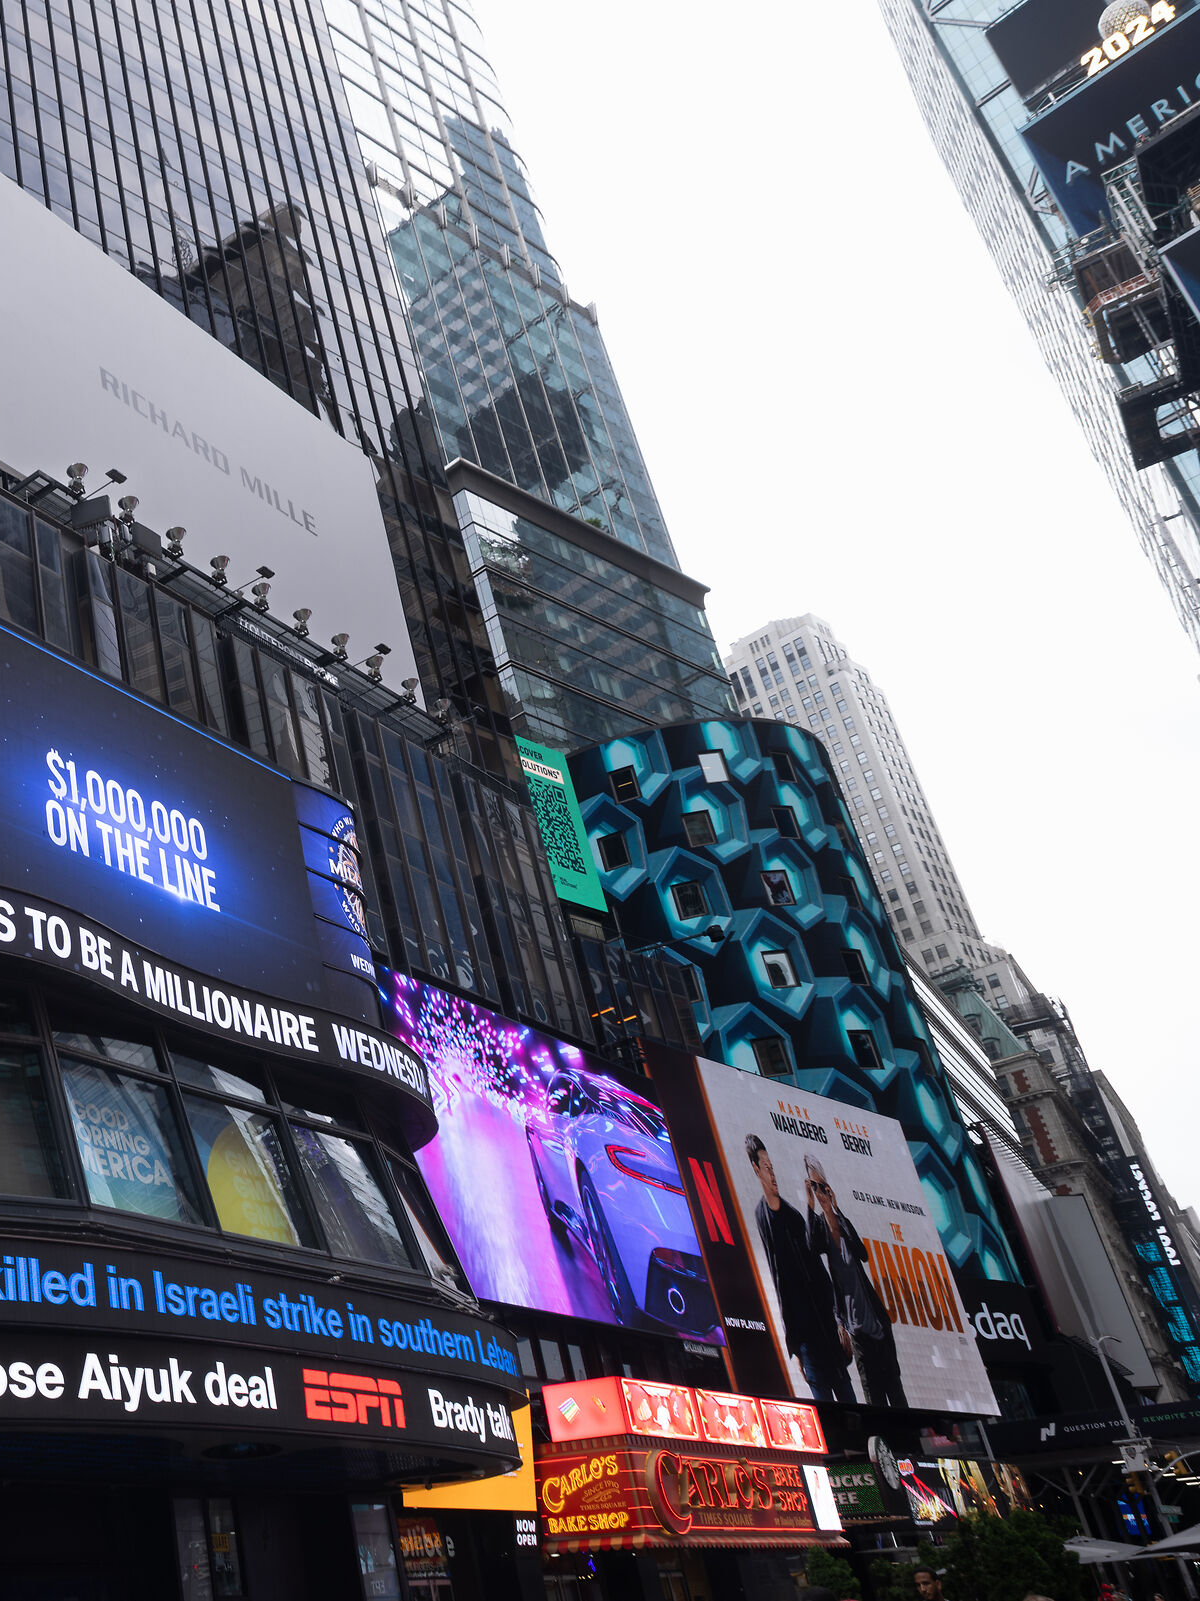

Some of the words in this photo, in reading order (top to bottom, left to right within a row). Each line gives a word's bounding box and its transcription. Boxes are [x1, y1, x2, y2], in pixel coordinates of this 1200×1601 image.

[1080, 0, 1177, 77] 2024
[99, 366, 231, 476] RICHARD
[240, 466, 319, 537] MILLE
[46, 748, 208, 861] $1,000,000
[45, 799, 90, 858] ON
[95, 819, 154, 885] THE
[159, 847, 221, 913] LINE
[24, 906, 72, 959] TO
[79, 926, 115, 980] BE
[120, 949, 140, 994] A
[142, 960, 320, 1053] MILLIONAIRE
[72, 1099, 129, 1131] GOOD
[777, 1099, 811, 1120] MARK
[834, 1116, 870, 1138] HALLE
[770, 1111, 828, 1144] WAHLBERG
[840, 1132, 874, 1157] BERRY
[852, 1190, 866, 1202] OLD
[865, 1193, 887, 1207] FLAME.
[886, 1199, 901, 1210] NEW
[889, 1222, 904, 1242] THE
[862, 1237, 964, 1333] UNION
[106, 1264, 145, 1312] in
[152, 1270, 258, 1327] Israeli
[263, 1291, 344, 1339] strike
[347, 1302, 375, 1345] in
[377, 1315, 474, 1361] southern
[725, 1317, 741, 1328] NOW
[740, 1319, 766, 1332] PLAYING
[77, 1352, 197, 1413] Aiyuk
[204, 1361, 278, 1411] deal
[302, 1368, 406, 1429] ESPN
[427, 1388, 486, 1444] Brady
[486, 1402, 514, 1442] talk
[1063, 1421, 1106, 1432] QUESTION
[1109, 1417, 1136, 1429] TODY
[1143, 1412, 1187, 1423] REWRITE
[542, 1454, 619, 1513] CARLO'S
[584, 1481, 603, 1497] SINCE
[604, 1479, 620, 1489] 1910
[771, 1466, 804, 1488] BAKE
[580, 1503, 600, 1512] TIMES
[600, 1501, 628, 1510] SQUARE
[778, 1490, 808, 1512] SHOP
[516, 1519, 536, 1533] NOW
[548, 1515, 588, 1534] BAKE
[588, 1511, 630, 1531] SHOP
[700, 1511, 723, 1525] TIMES
[723, 1512, 755, 1528] SQUARE
[516, 1533, 538, 1546] OPEN
